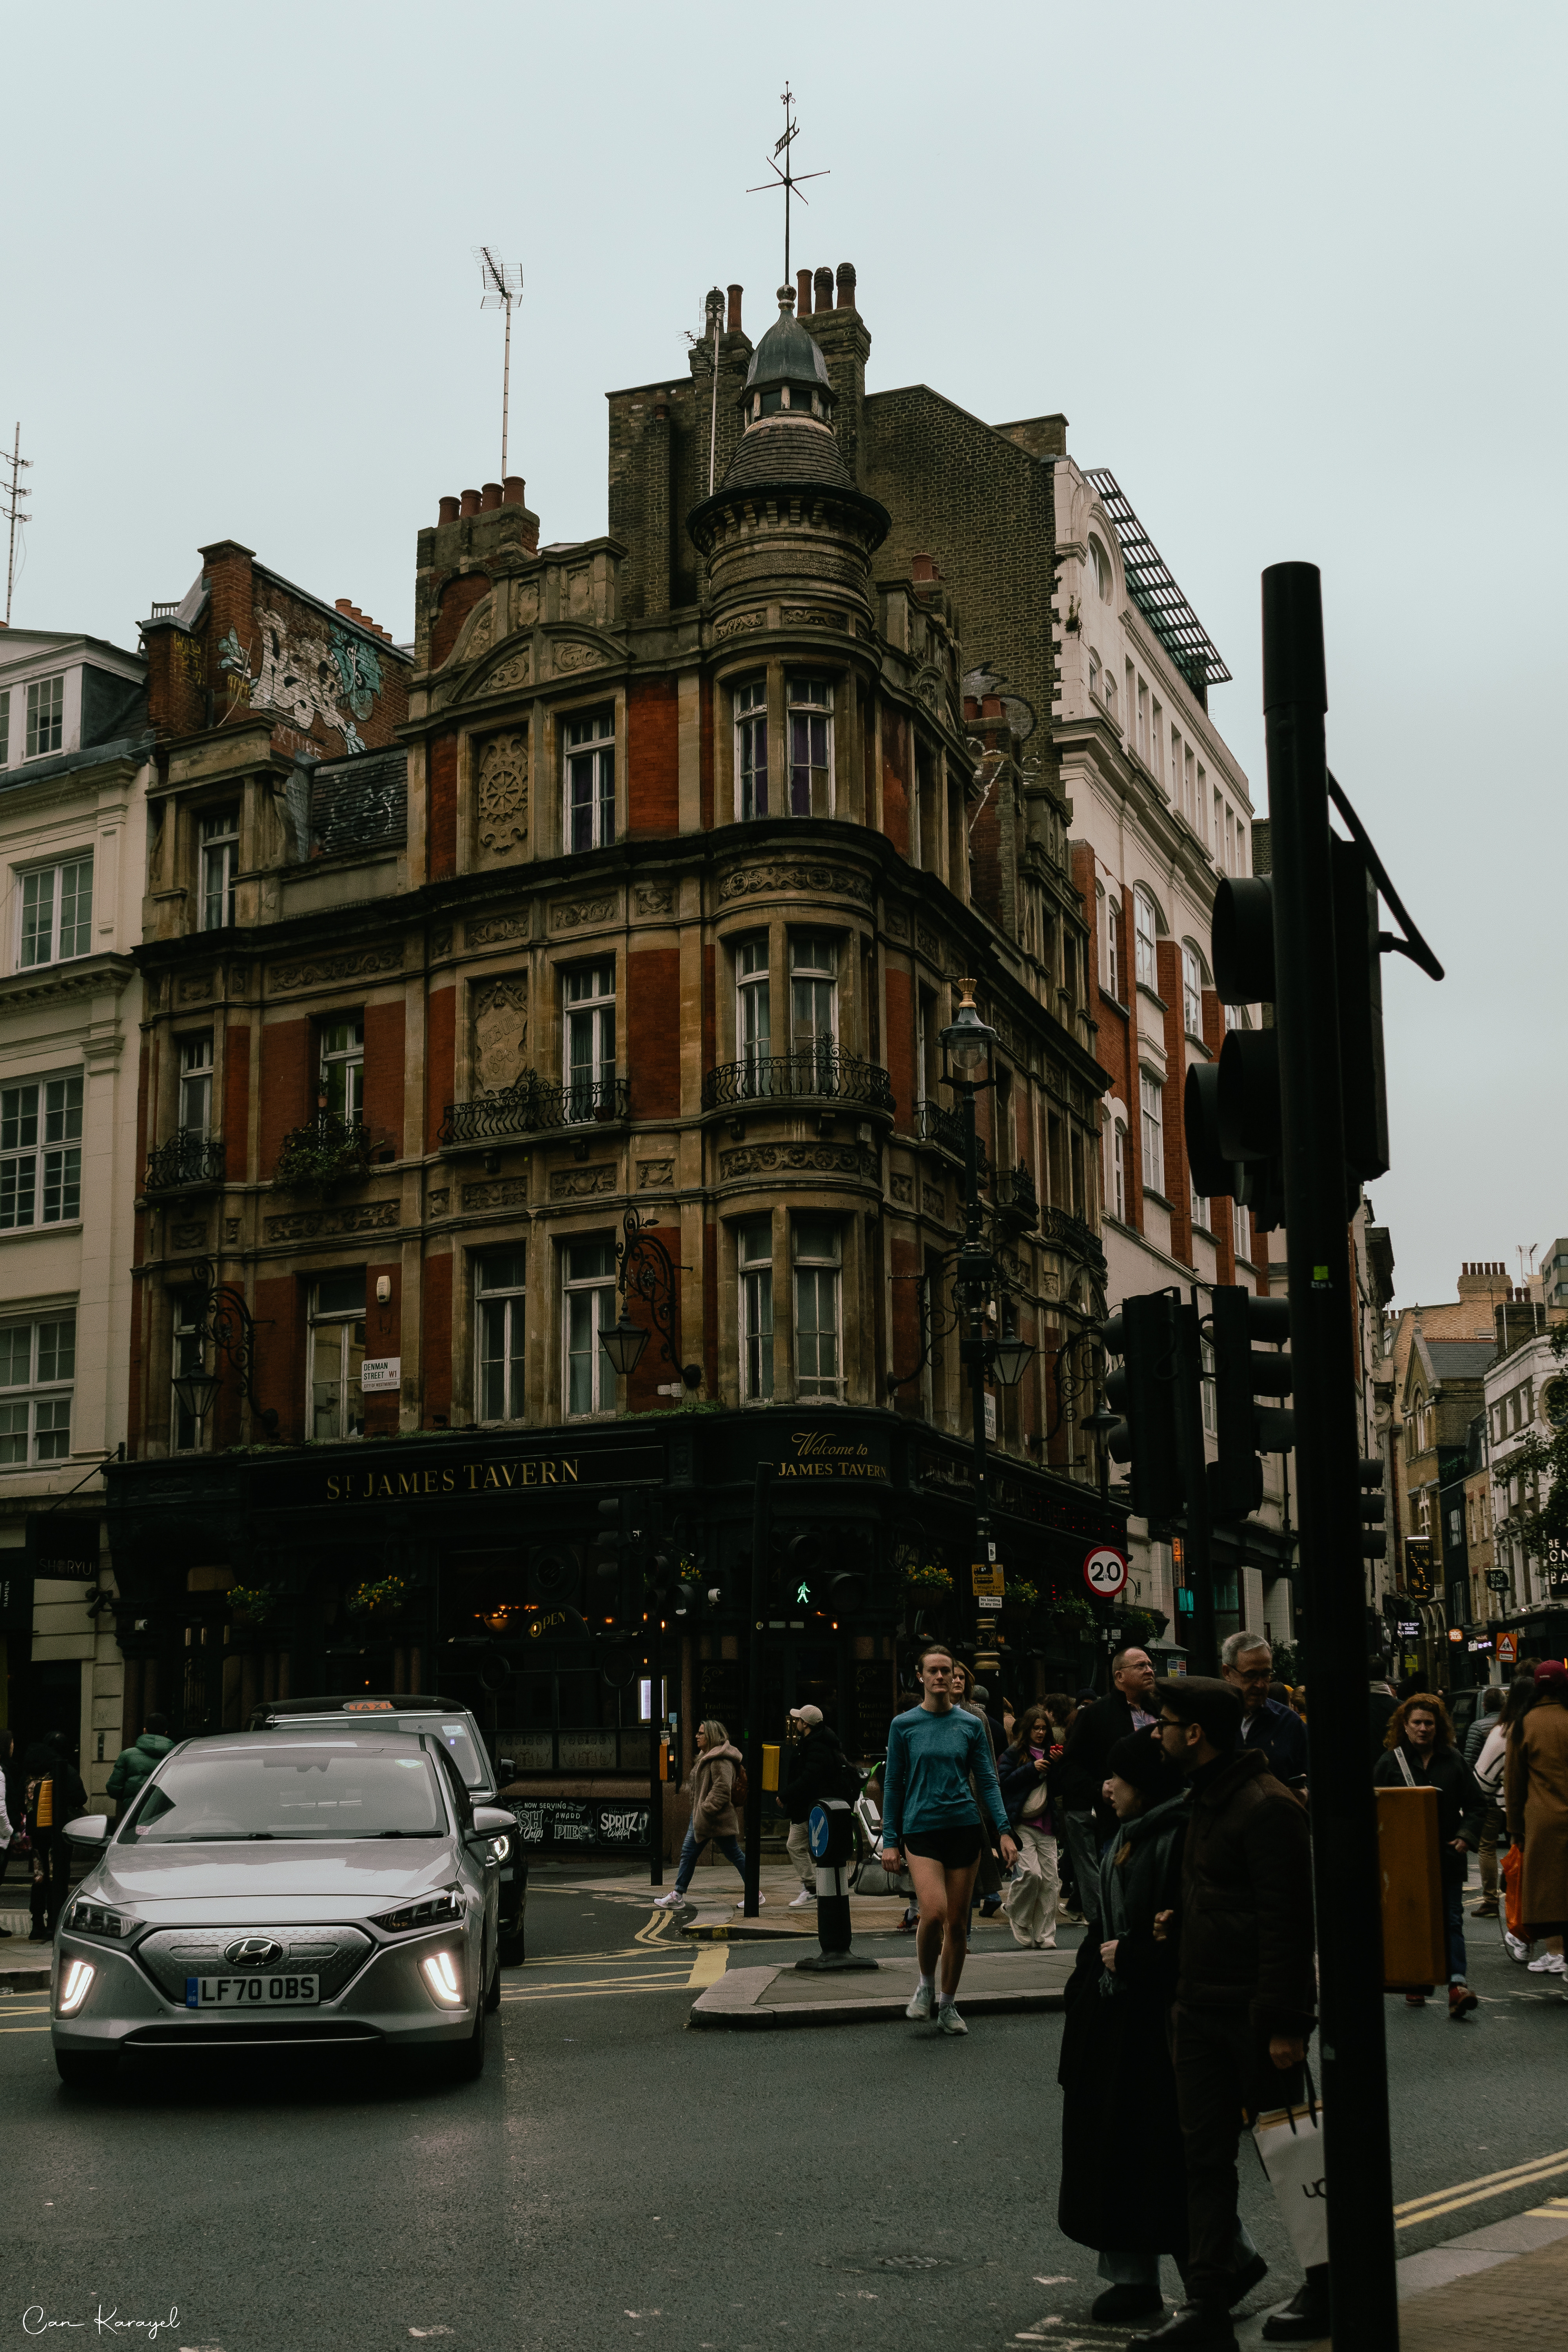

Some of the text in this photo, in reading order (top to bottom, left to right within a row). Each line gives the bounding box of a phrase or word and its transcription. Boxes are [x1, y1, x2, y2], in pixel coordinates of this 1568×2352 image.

[364, 1362, 388, 1371] DENMAN
[364, 1372, 384, 1380] STREET
[792, 1431, 868, 1456] Welcome to
[363, 1469, 454, 1497] JAMES
[463, 1459, 579, 1490] TAVERN
[779, 1463, 886, 1478] JAMES TAVERN
[1548, 1539, 1560, 1548] BE
[1091, 1561, 1120, 1581] 20
[1410, 1552, 1431, 1590] LYRIC
[528, 1611, 565, 1638] OPEN
[539, 1801, 566, 1811] SERVING
[554, 1824, 585, 1840] PIES
[601, 1812, 638, 1832] SPRITZ
[202, 1977, 314, 2001] LF70 OBS
